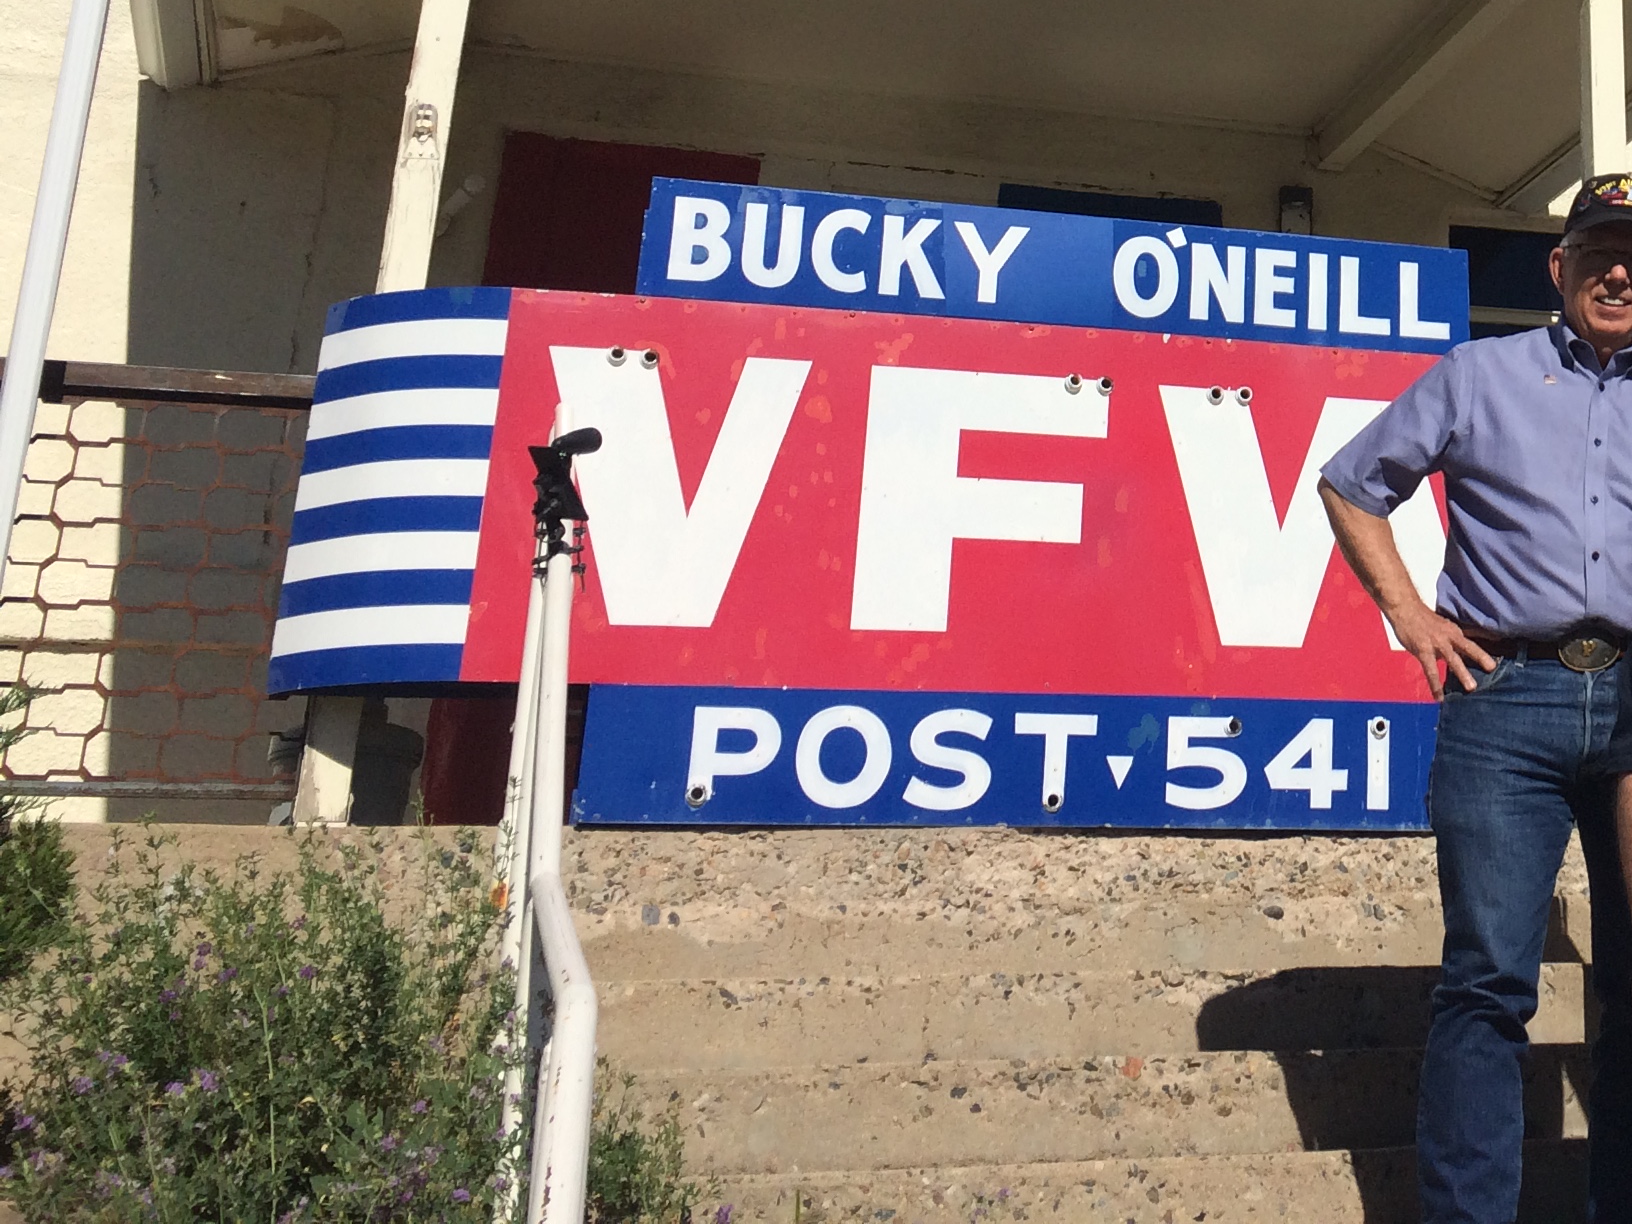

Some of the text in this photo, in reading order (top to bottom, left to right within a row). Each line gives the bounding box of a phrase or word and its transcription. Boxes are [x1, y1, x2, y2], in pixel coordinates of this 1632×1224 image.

[666, 196, 1452, 340] BUCKY O'NEILL
[549, 345, 1449, 651] VFW
[686, 705, 1391, 812] POST 541
